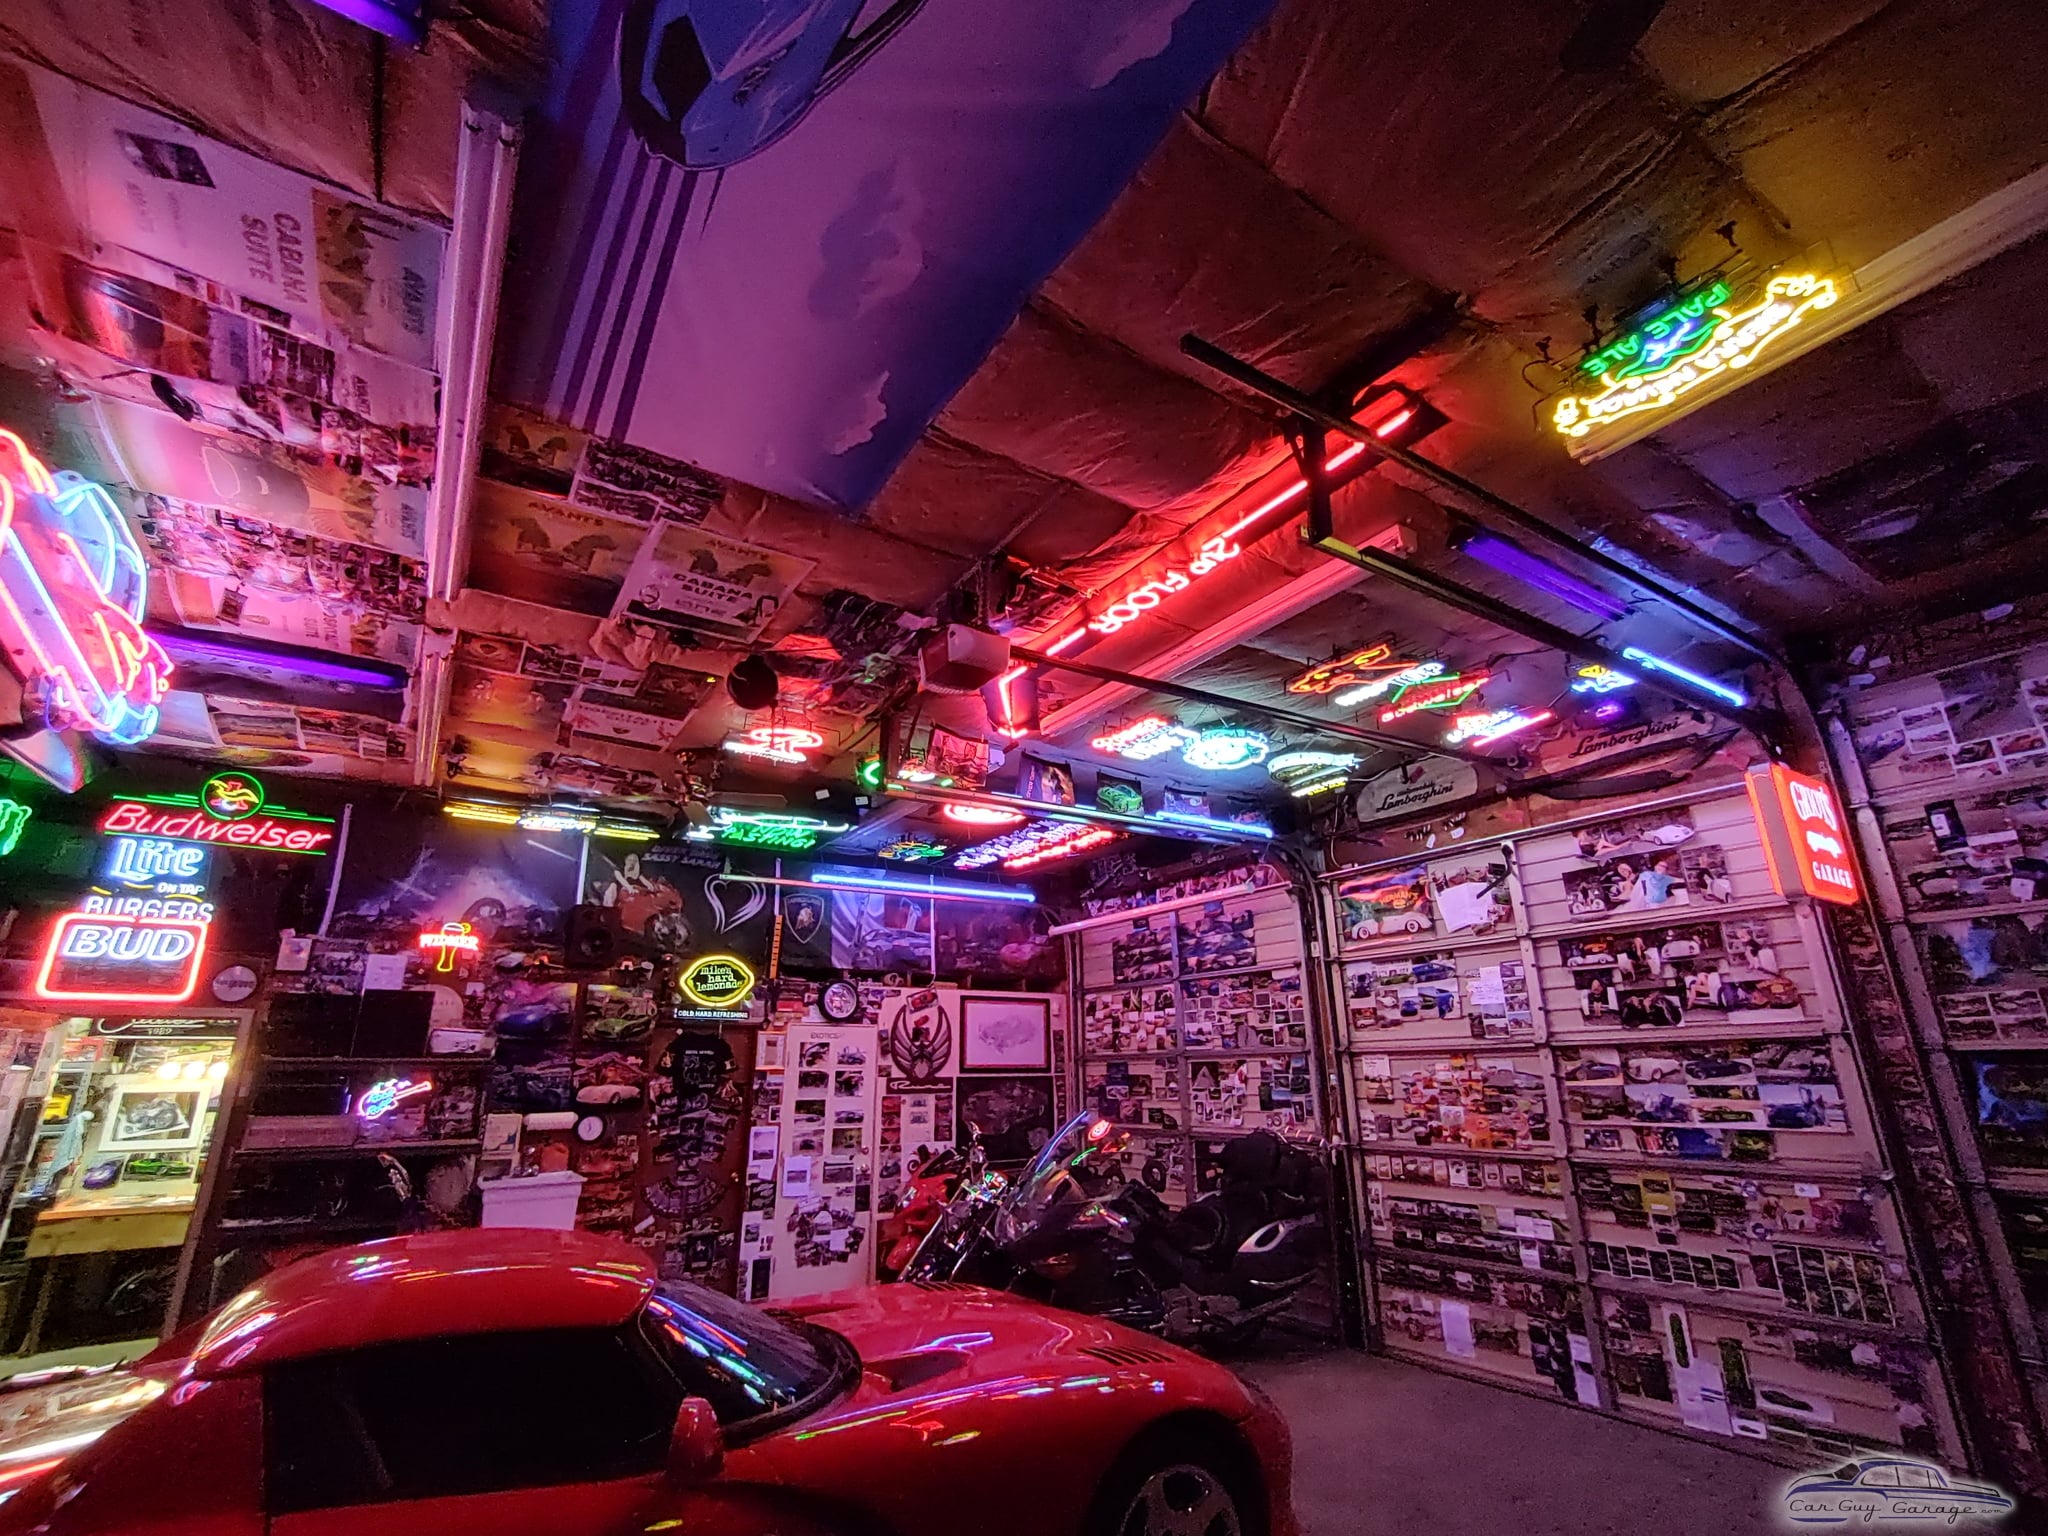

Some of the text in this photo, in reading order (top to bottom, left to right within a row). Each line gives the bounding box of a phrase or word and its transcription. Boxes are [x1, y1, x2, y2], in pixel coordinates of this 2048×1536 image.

[241, 214, 275, 285] SUITE
[274, 213, 307, 305] CABANA
[1581, 281, 1733, 377] PALE ALE
[673, 573, 753, 599] CABANA
[681, 584, 739, 602] SUITE
[1088, 570, 1190, 634] FLOOR
[1569, 719, 1680, 758] Lamborghini
[1376, 781, 1455, 813] Lamborghini
[104, 803, 332, 851] Budweiser
[110, 838, 204, 882] Lite
[1812, 861, 1853, 889] GARAGE
[157, 882, 206, 895] ON TAP
[84, 896, 214, 923] BURGERS
[62, 924, 196, 961] BUD
[708, 973, 737, 984] hard
[695, 1010, 712, 1018] HARD
[713, 1011, 748, 1019] REFRESHING
